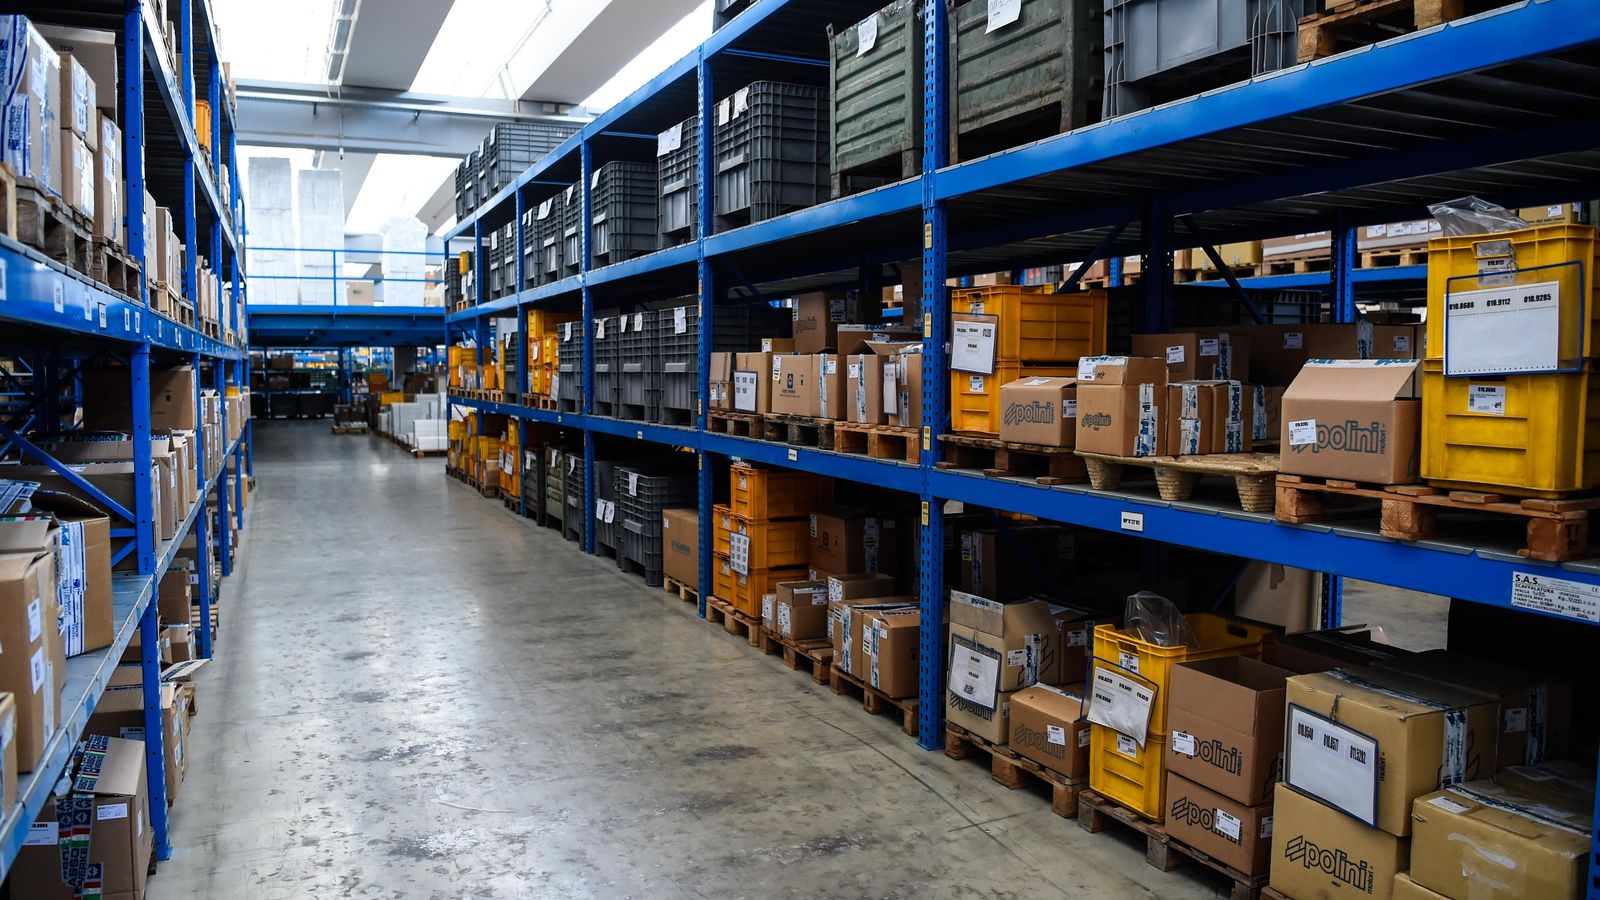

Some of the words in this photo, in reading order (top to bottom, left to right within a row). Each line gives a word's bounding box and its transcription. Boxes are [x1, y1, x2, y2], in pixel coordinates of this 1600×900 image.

[1015, 401, 1050, 425] polini
[1312, 420, 1379, 453] polini
[1515, 574, 1541, 585] S.A.S.
[1303, 839, 1368, 891] polini
